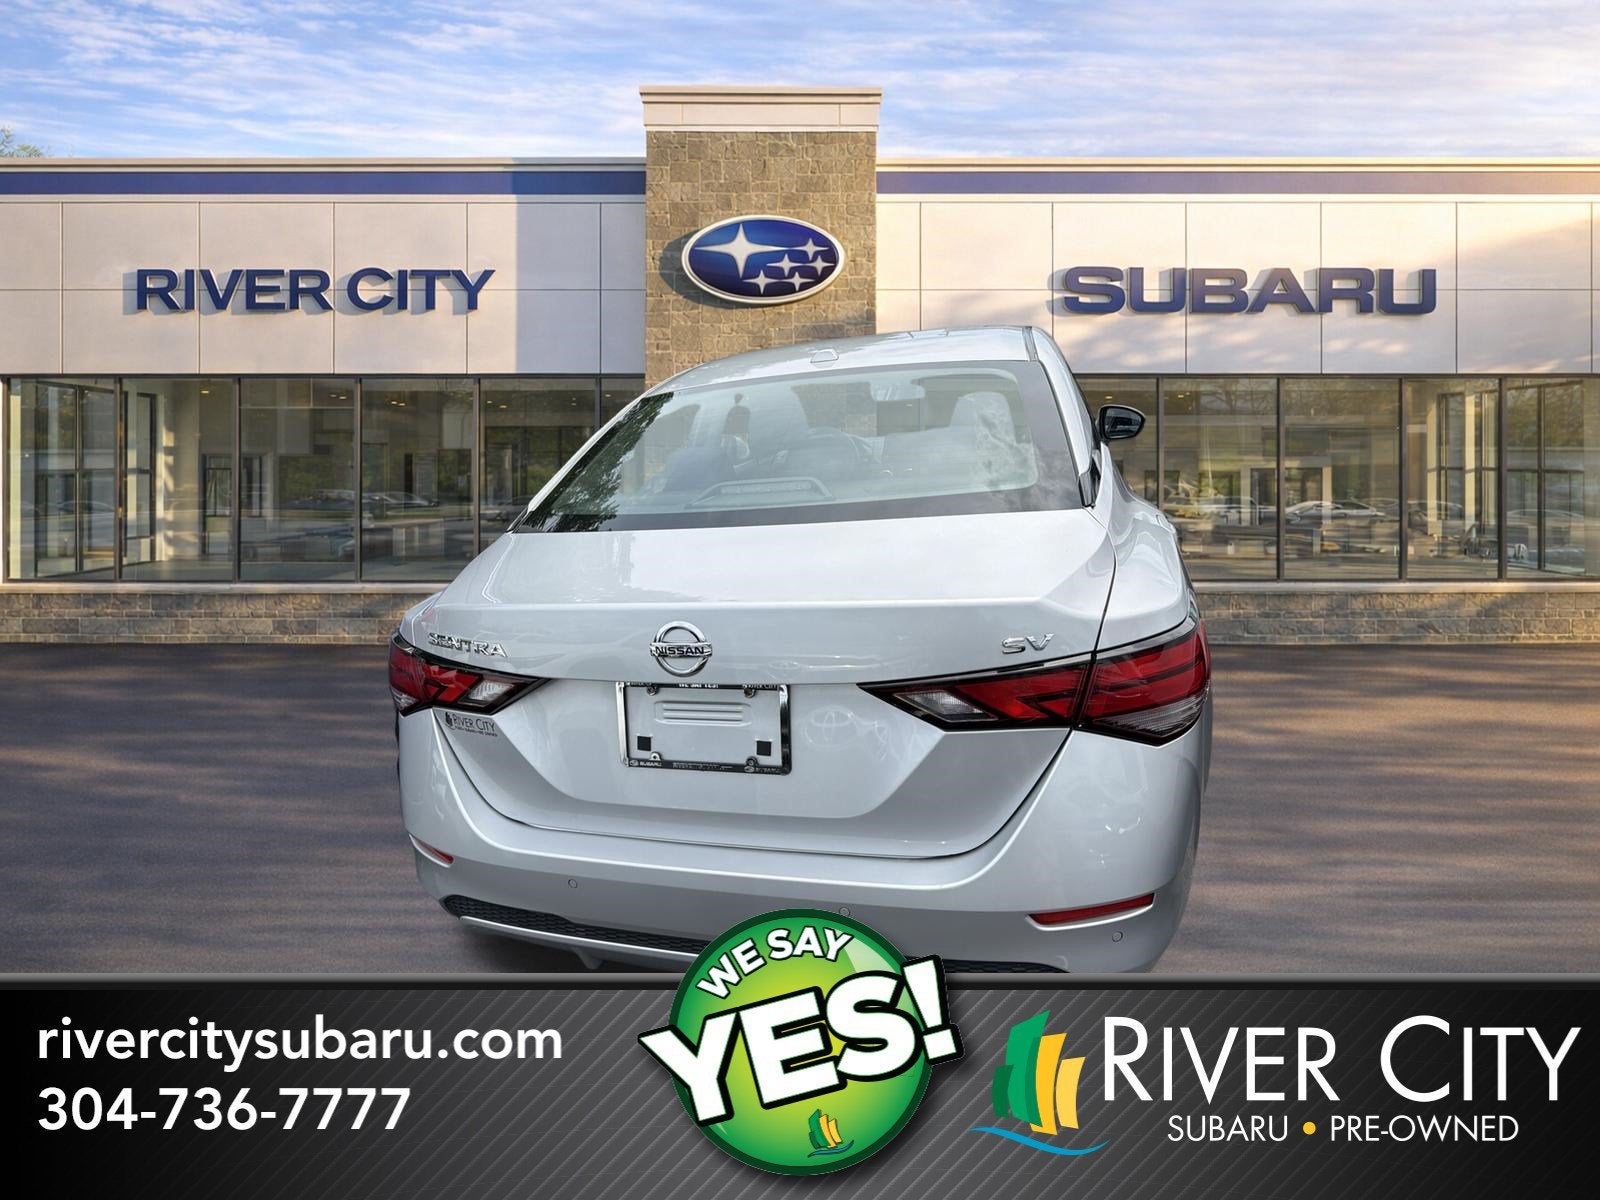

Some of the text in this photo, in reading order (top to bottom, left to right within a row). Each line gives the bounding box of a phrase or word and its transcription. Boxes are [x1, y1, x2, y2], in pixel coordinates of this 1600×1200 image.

[136, 267, 496, 311] RIVER CITY
[1062, 266, 1437, 315] SUBARU
[428, 632, 508, 657] SENTRA
[655, 646, 705, 655] NISSAN
[1001, 633, 1054, 654] SV
[451, 713, 475, 728] RIVER
[475, 718, 495, 732] CITY
